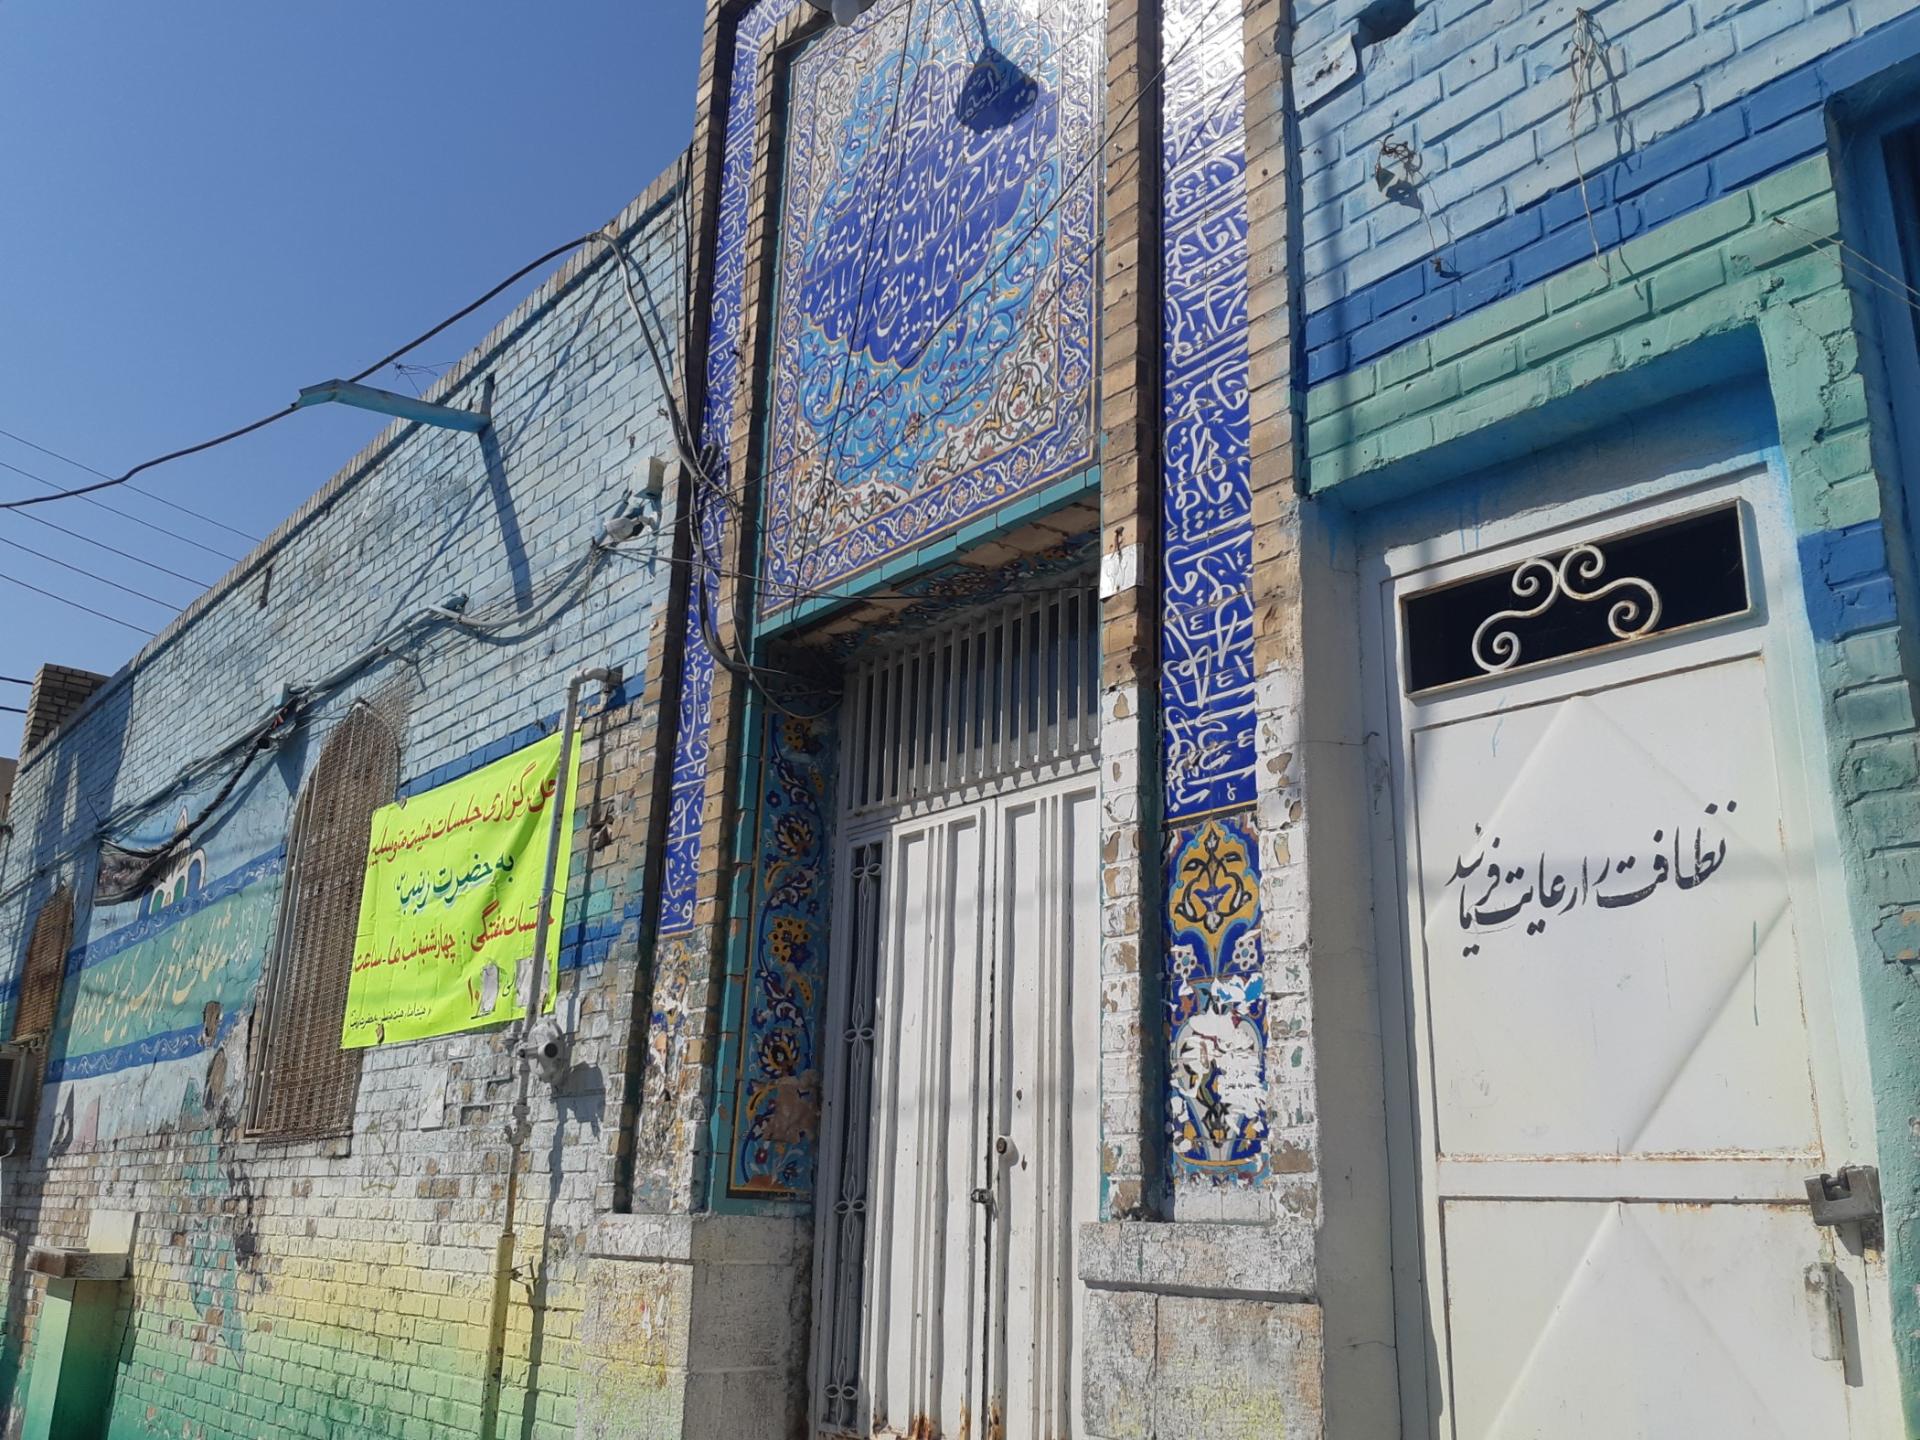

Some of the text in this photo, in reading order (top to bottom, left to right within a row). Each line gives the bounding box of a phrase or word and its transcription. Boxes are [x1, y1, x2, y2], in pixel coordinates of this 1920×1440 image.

[432, 794, 482, 833] جلسات
[481, 761, 537, 823] برگزاری
[433, 853, 493, 904] حضرت
[495, 851, 514, 882] به
[1579, 854, 1611, 906] را
[1595, 799, 1738, 909] نظافت
[1473, 851, 1579, 937] رعایت
